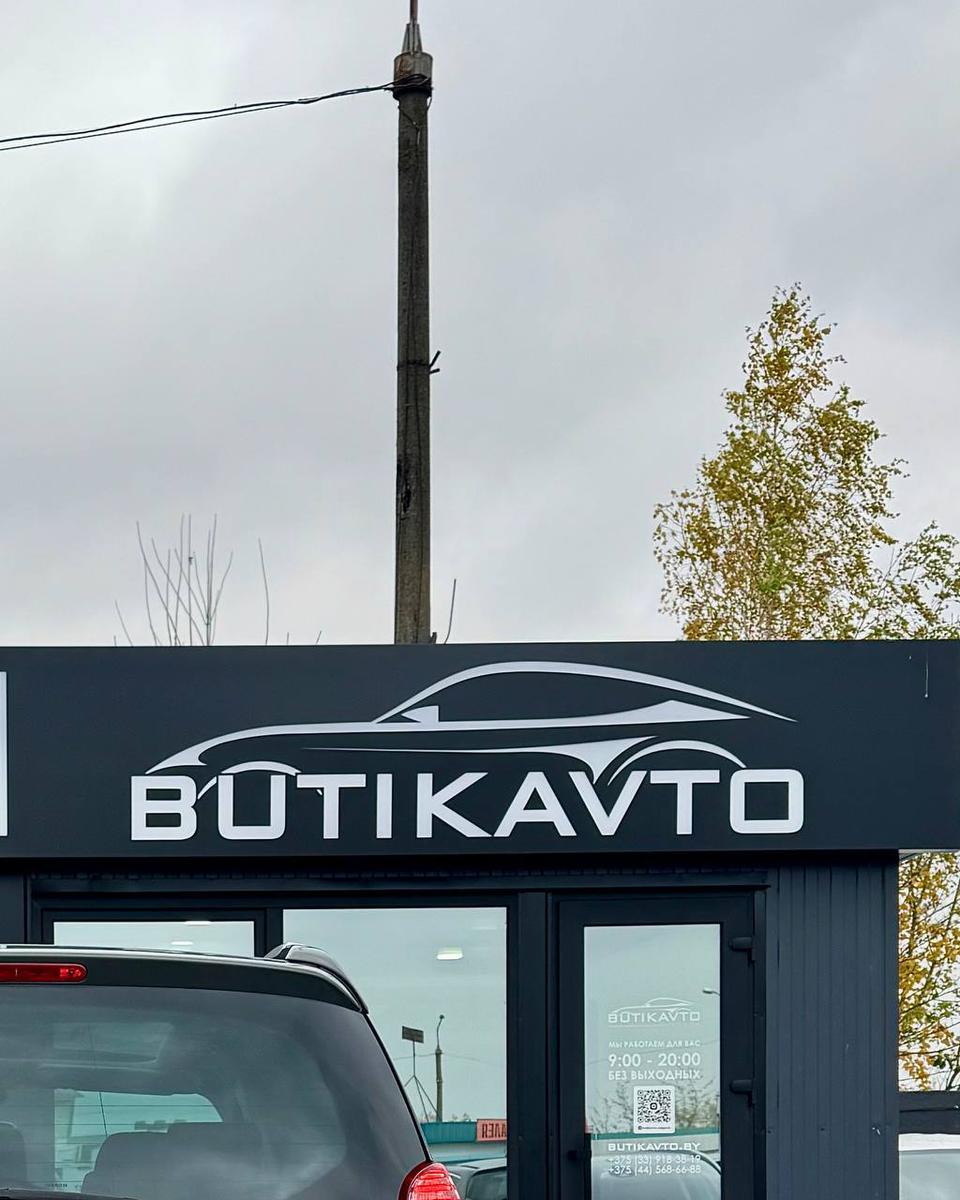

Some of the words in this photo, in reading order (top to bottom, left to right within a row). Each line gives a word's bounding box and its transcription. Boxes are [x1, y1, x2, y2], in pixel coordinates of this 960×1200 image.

[130, 767, 805, 842] BUTIKAVTO
[607, 1011, 700, 1023] BUTIKAVTO
[608, 1040, 623, 1049] МЫ
[624, 1040, 665, 1048] РАБОТАЕМ
[666, 1040, 682, 1048] ДЛЯ
[684, 1039, 701, 1047] ВАС
[608, 1053, 641, 1067] 9:00
[657, 1052, 701, 1066] 20:00
[608, 1070, 627, 1081] БЕЗ
[631, 1069, 701, 1081] ВЫХОДНЫХ
[607, 1142, 701, 1152] BUTIKAVTO.BY
[608, 1165, 632, 1175] +375
[634, 1165, 653, 1176] (44)
